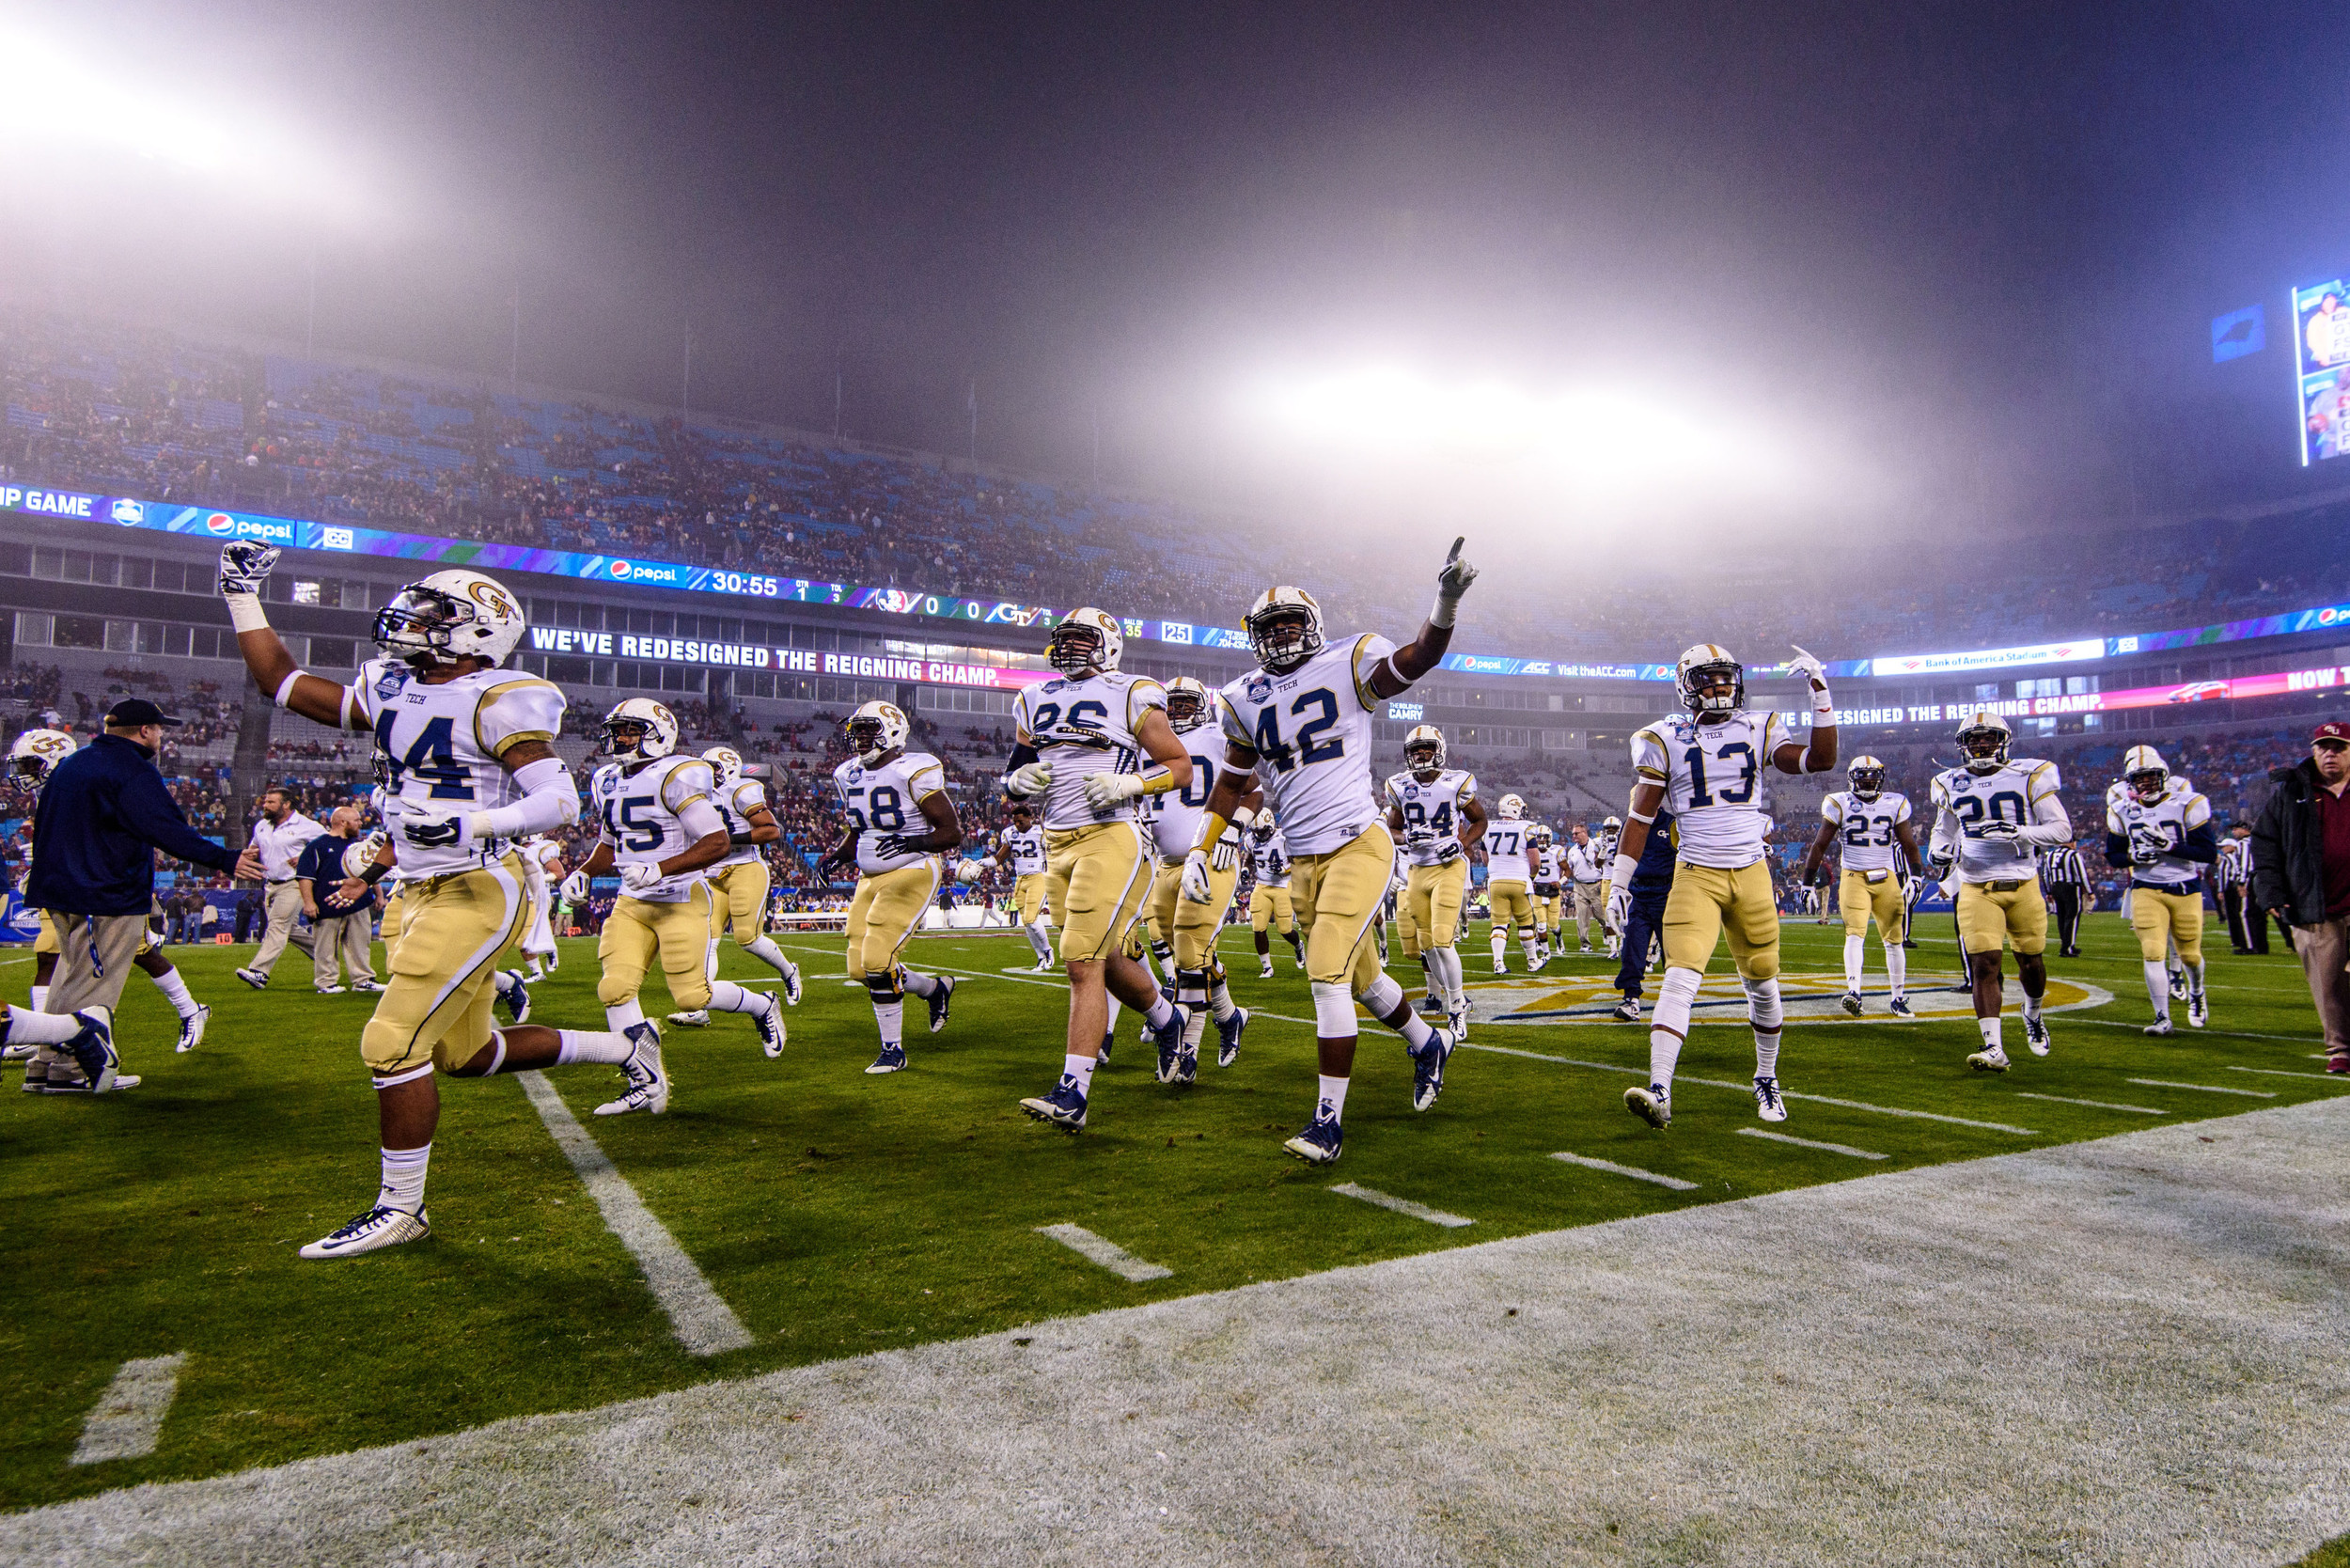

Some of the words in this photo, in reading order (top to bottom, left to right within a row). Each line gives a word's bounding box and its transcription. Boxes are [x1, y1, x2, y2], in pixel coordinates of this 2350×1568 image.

[26, 491, 92, 517] GAME
[237, 521, 290, 538] pepsi
[634, 567, 676, 581] pepsi
[713, 572, 777, 596] 30:55
[796, 580, 808, 588] QTR
[831, 584, 842, 592] TOL
[798, 588, 806, 601] 1
[833, 593, 839, 603] 3
[926, 597, 938, 614] 0
[967, 603, 979, 618] 0
[1044, 617, 1051, 625] 3
[1125, 625, 1142, 637] 35
[1167, 625, 1186, 640] 25
[532, 628, 612, 654] WE'VE
[621, 635, 769, 667] REDESIGNED
[776, 650, 817, 670] THE
[824, 654, 921, 681] REIGNING
[929, 664, 999, 686] CHAMP.
[1925, 658, 1950, 668] Bank
[1951, 656, 1963, 666] of
[1964, 653, 2004, 666] America
[2006, 650, 2047, 662] Stadium
[1477, 661, 1501, 670] pepsi
[1521, 662, 1551, 674] ACC
[1558, 665, 1578, 676] Visit
[1580, 666, 1636, 678] theACC.com
[2287, 667, 2338, 690] NOW
[1277, 680, 1298, 693] TECH
[406, 693, 427, 705] TECH
[1388, 709, 1424, 720] CAMRY
[1908, 706, 1940, 722] THE
[2035, 694, 2105, 714] CHAMP.
[1254, 686, 1345, 775] 42
[1705, 731, 1724, 740] TECH
[1684, 742, 1758, 809] 13
[846, 786, 906, 832] 58
[1846, 814, 1894, 847] 23
[1010, 839, 1039, 858] 52
[1488, 832, 1520, 855] 77
[219, 934, 230, 943] 10
